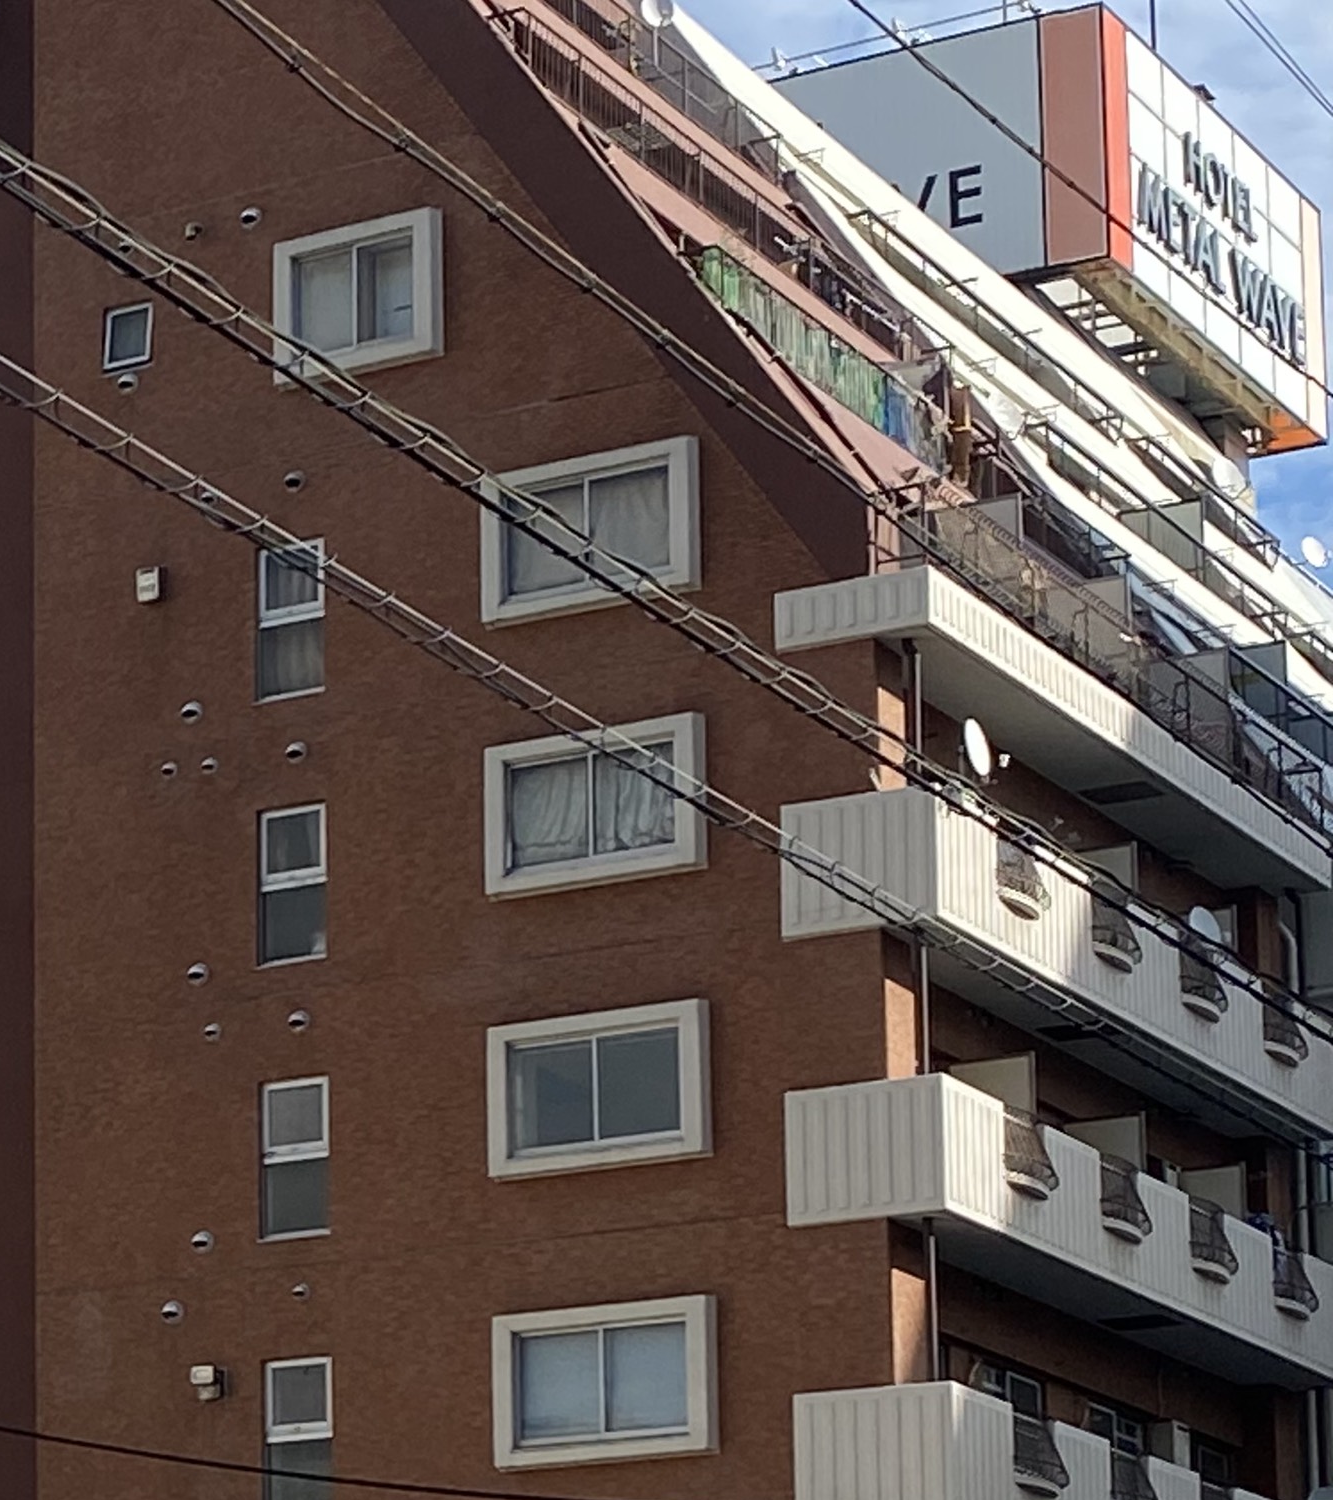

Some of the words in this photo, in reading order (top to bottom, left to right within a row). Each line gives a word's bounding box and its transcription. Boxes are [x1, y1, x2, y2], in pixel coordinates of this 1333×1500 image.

[1137, 162, 1226, 297] METAL
[1228, 247, 1308, 369] WAVE
[1183, 131, 1259, 244] HOTEL
